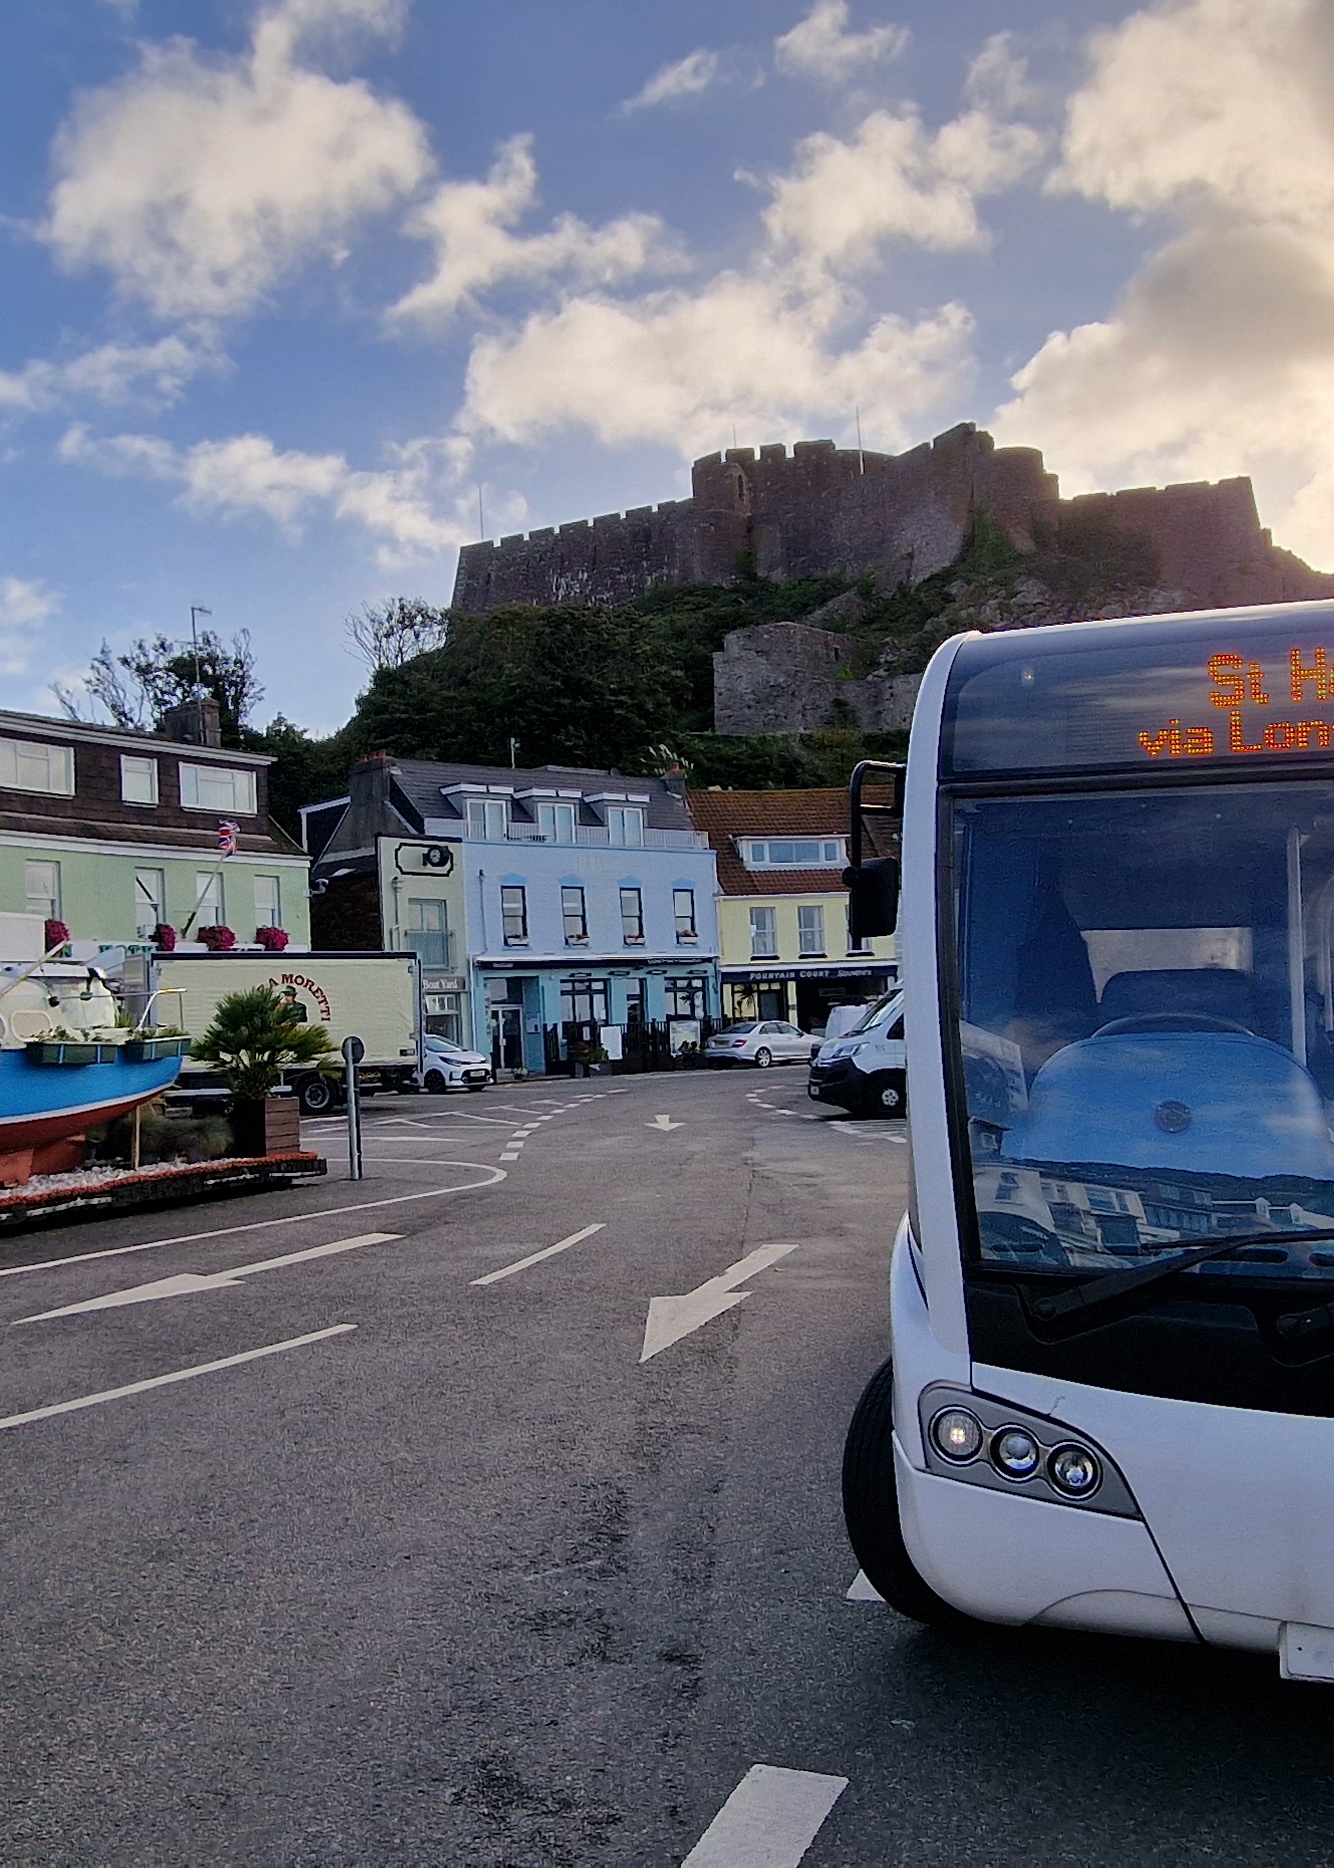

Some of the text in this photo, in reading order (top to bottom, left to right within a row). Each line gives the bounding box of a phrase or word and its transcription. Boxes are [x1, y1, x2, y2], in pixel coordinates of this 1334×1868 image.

[1207, 652, 1269, 708] St
[1138, 719, 1215, 757] via
[280, 973, 331, 1022] MORETTI
[440, 978, 458, 989] Yard
